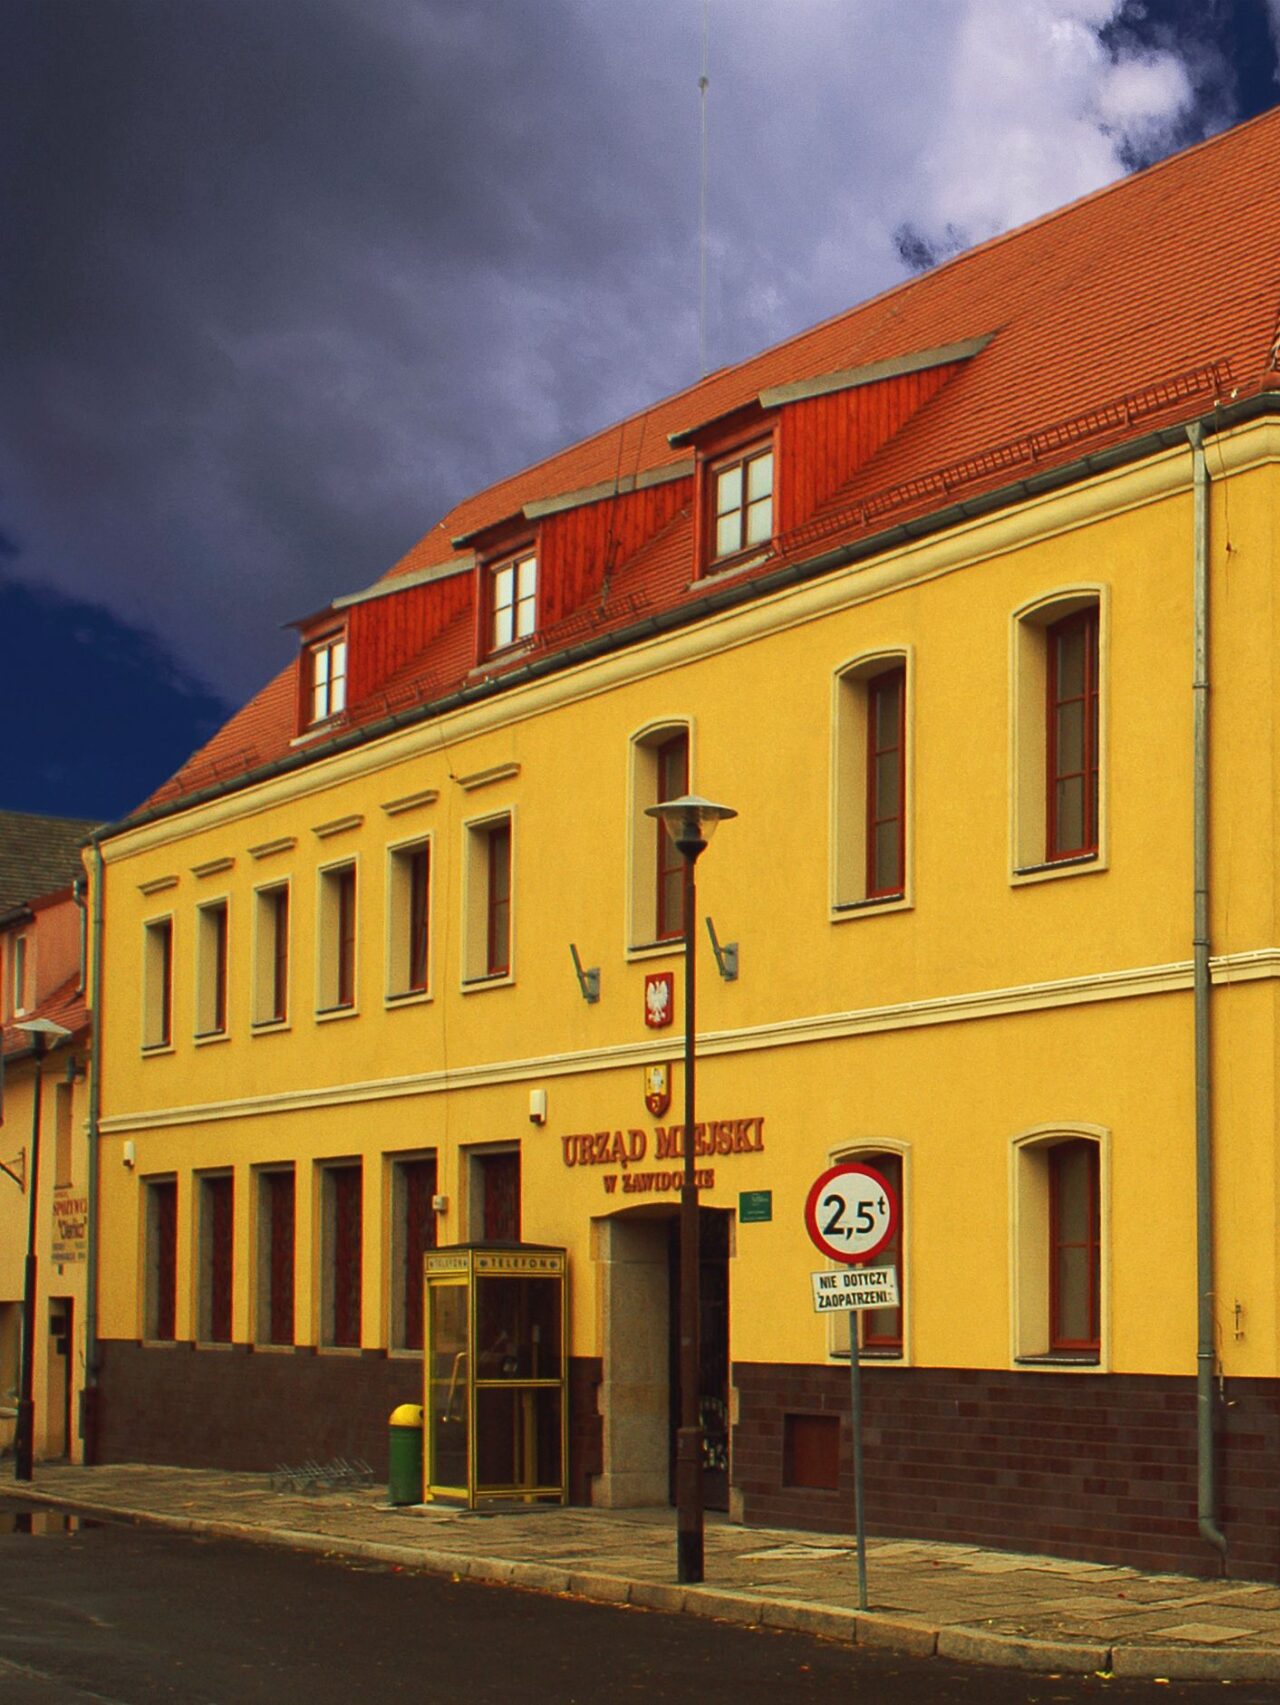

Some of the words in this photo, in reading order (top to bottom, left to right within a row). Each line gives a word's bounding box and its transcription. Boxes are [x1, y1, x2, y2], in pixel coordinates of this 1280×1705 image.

[561, 1129, 647, 1168] URZĄD
[603, 1175, 617, 1194] W
[622, 1169, 715, 1194] ZAWIDOIE
[491, 1257, 547, 1269] TELEFON
[819, 1275, 838, 1290] NIE
[843, 1271, 888, 1288] DOTYCZY
